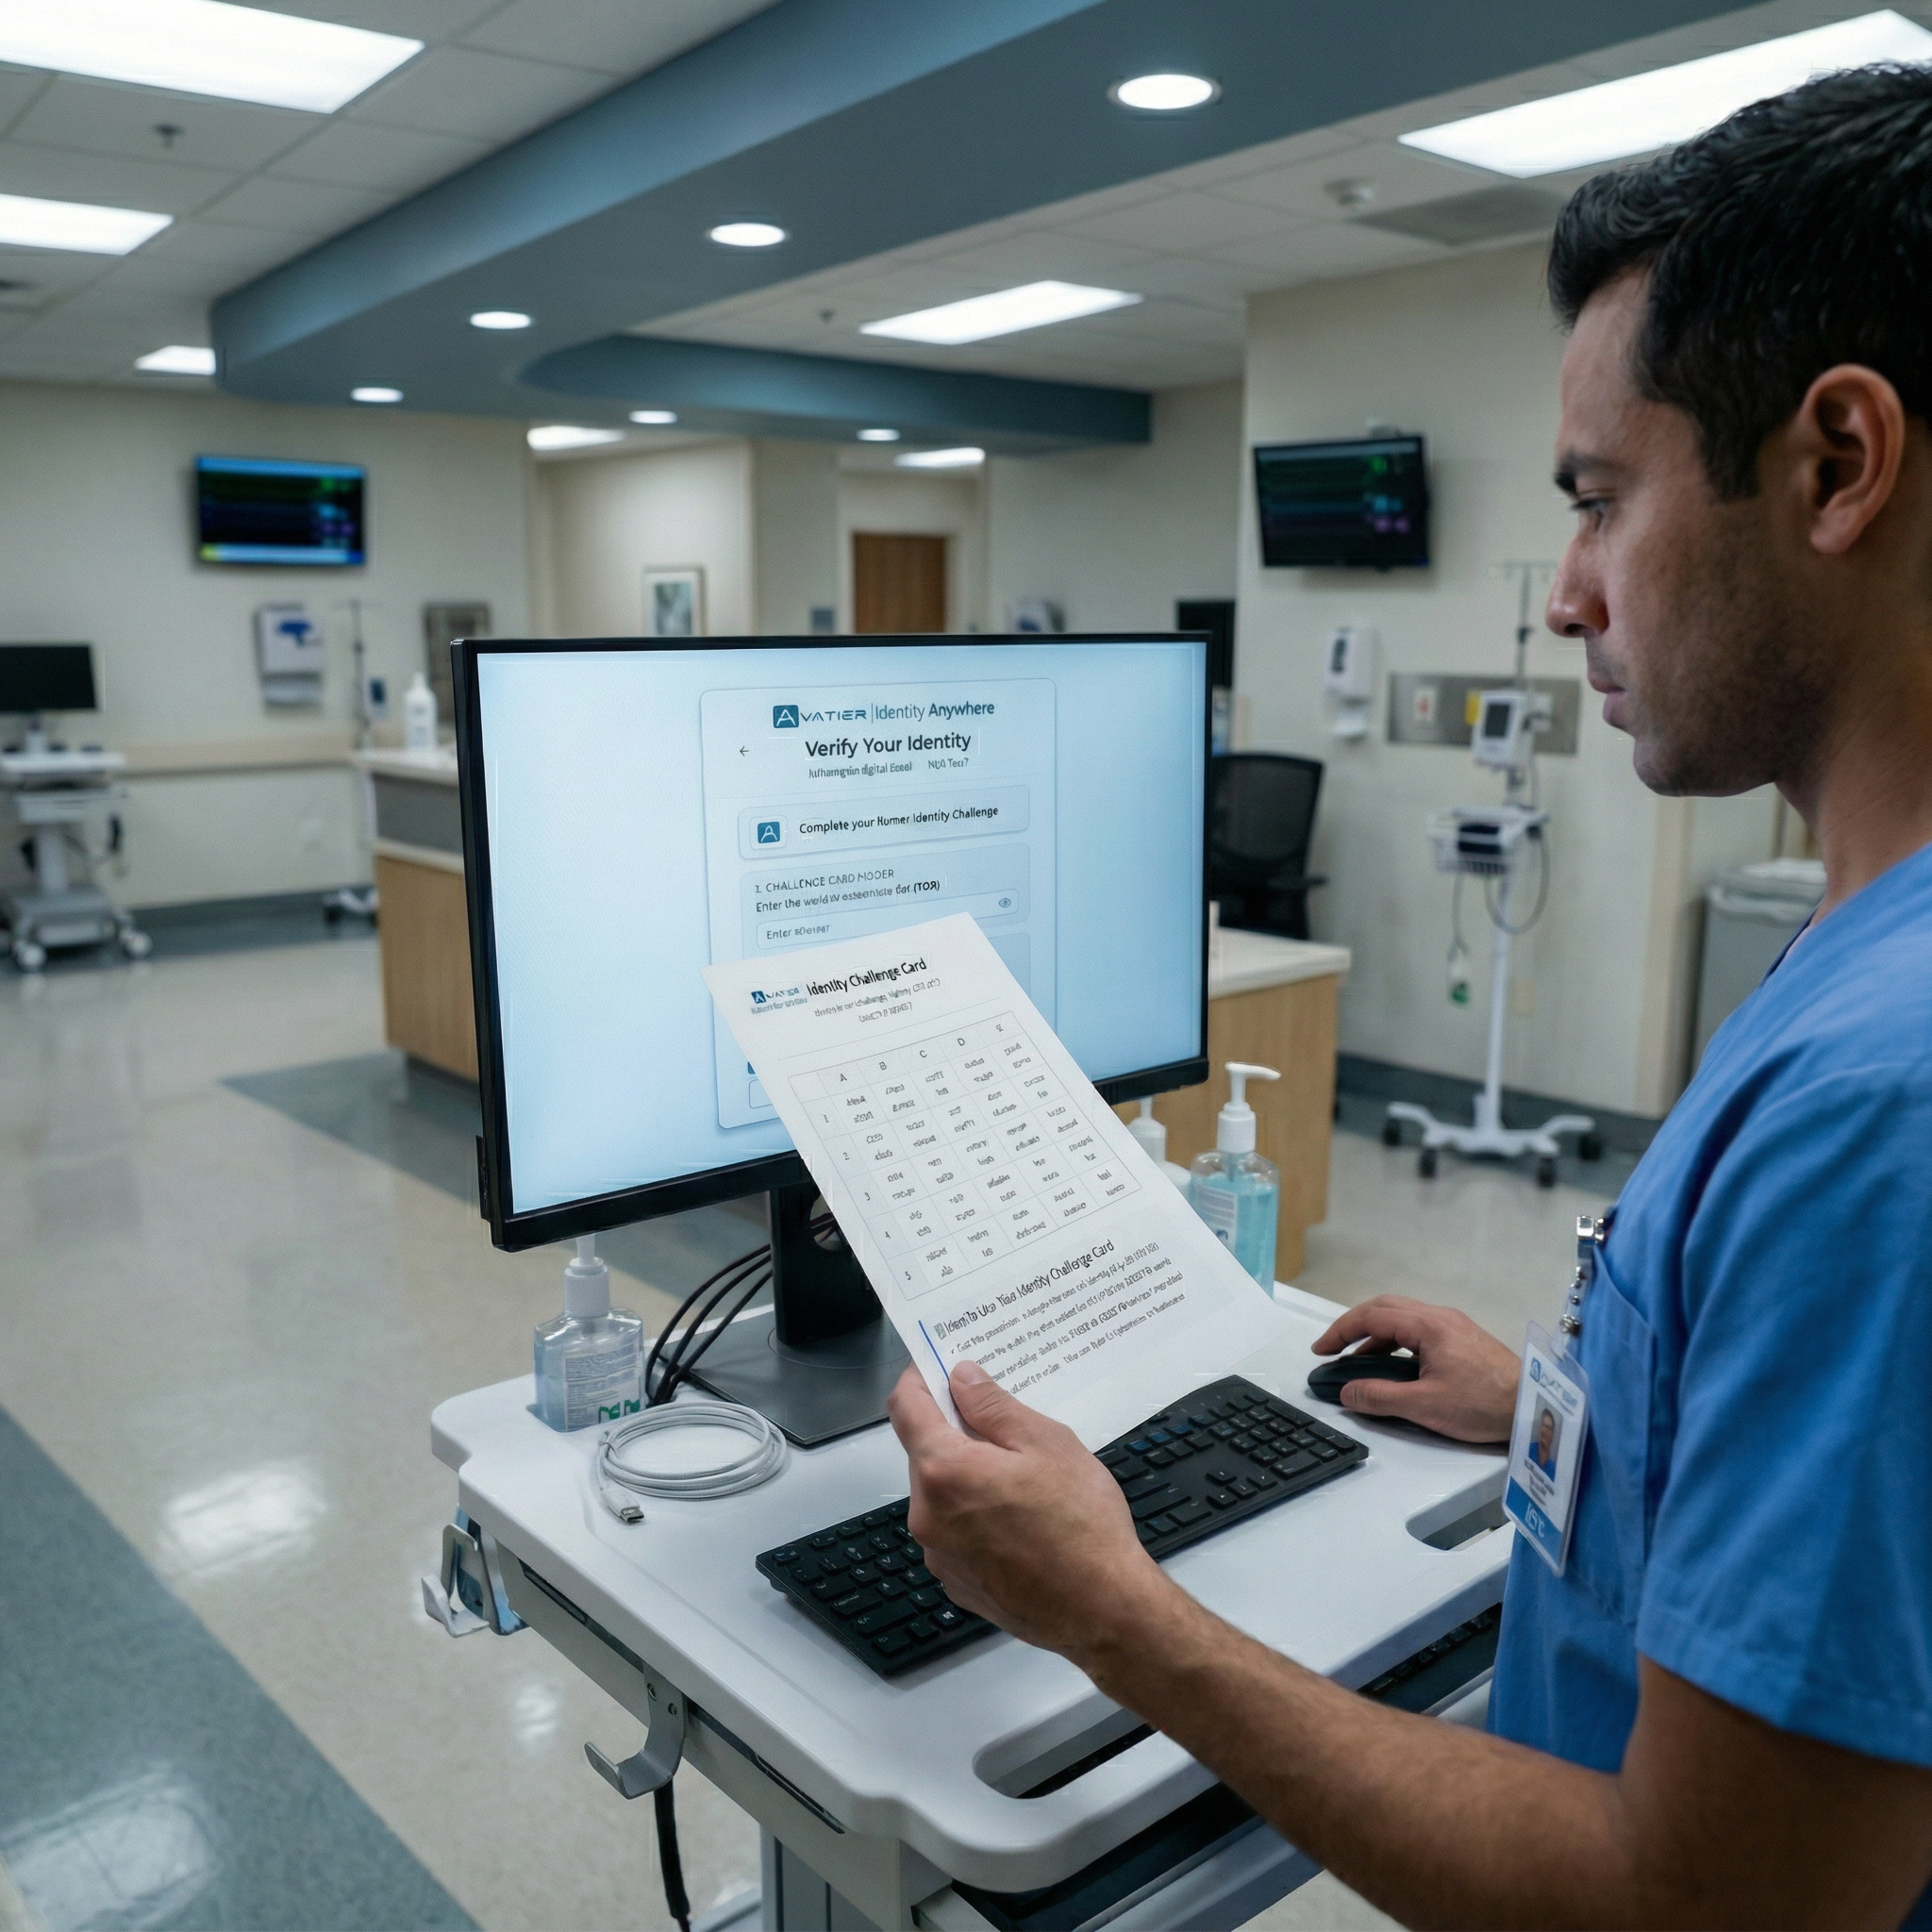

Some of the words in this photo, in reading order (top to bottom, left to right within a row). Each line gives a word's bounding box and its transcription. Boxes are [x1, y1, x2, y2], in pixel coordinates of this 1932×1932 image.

[875, 704, 925, 722] Identity
[928, 700, 995, 720] Anywhere
[805, 738, 858, 758] Verify
[862, 738, 903, 754] Your
[908, 732, 972, 752] Identity
[799, 820, 849, 835] Complete
[851, 818, 875, 832] your
[912, 809, 950, 824] Identity
[952, 806, 999, 820] Challenge
[756, 901, 783, 912] Enter
[849, 968, 902, 987] Challenge
[901, 957, 927, 974] Card
[839, 1073, 848, 1083] A
[919, 1049, 928, 1058] C
[957, 1037, 966, 1046] D
[1091, 1239, 1115, 1257] Card
